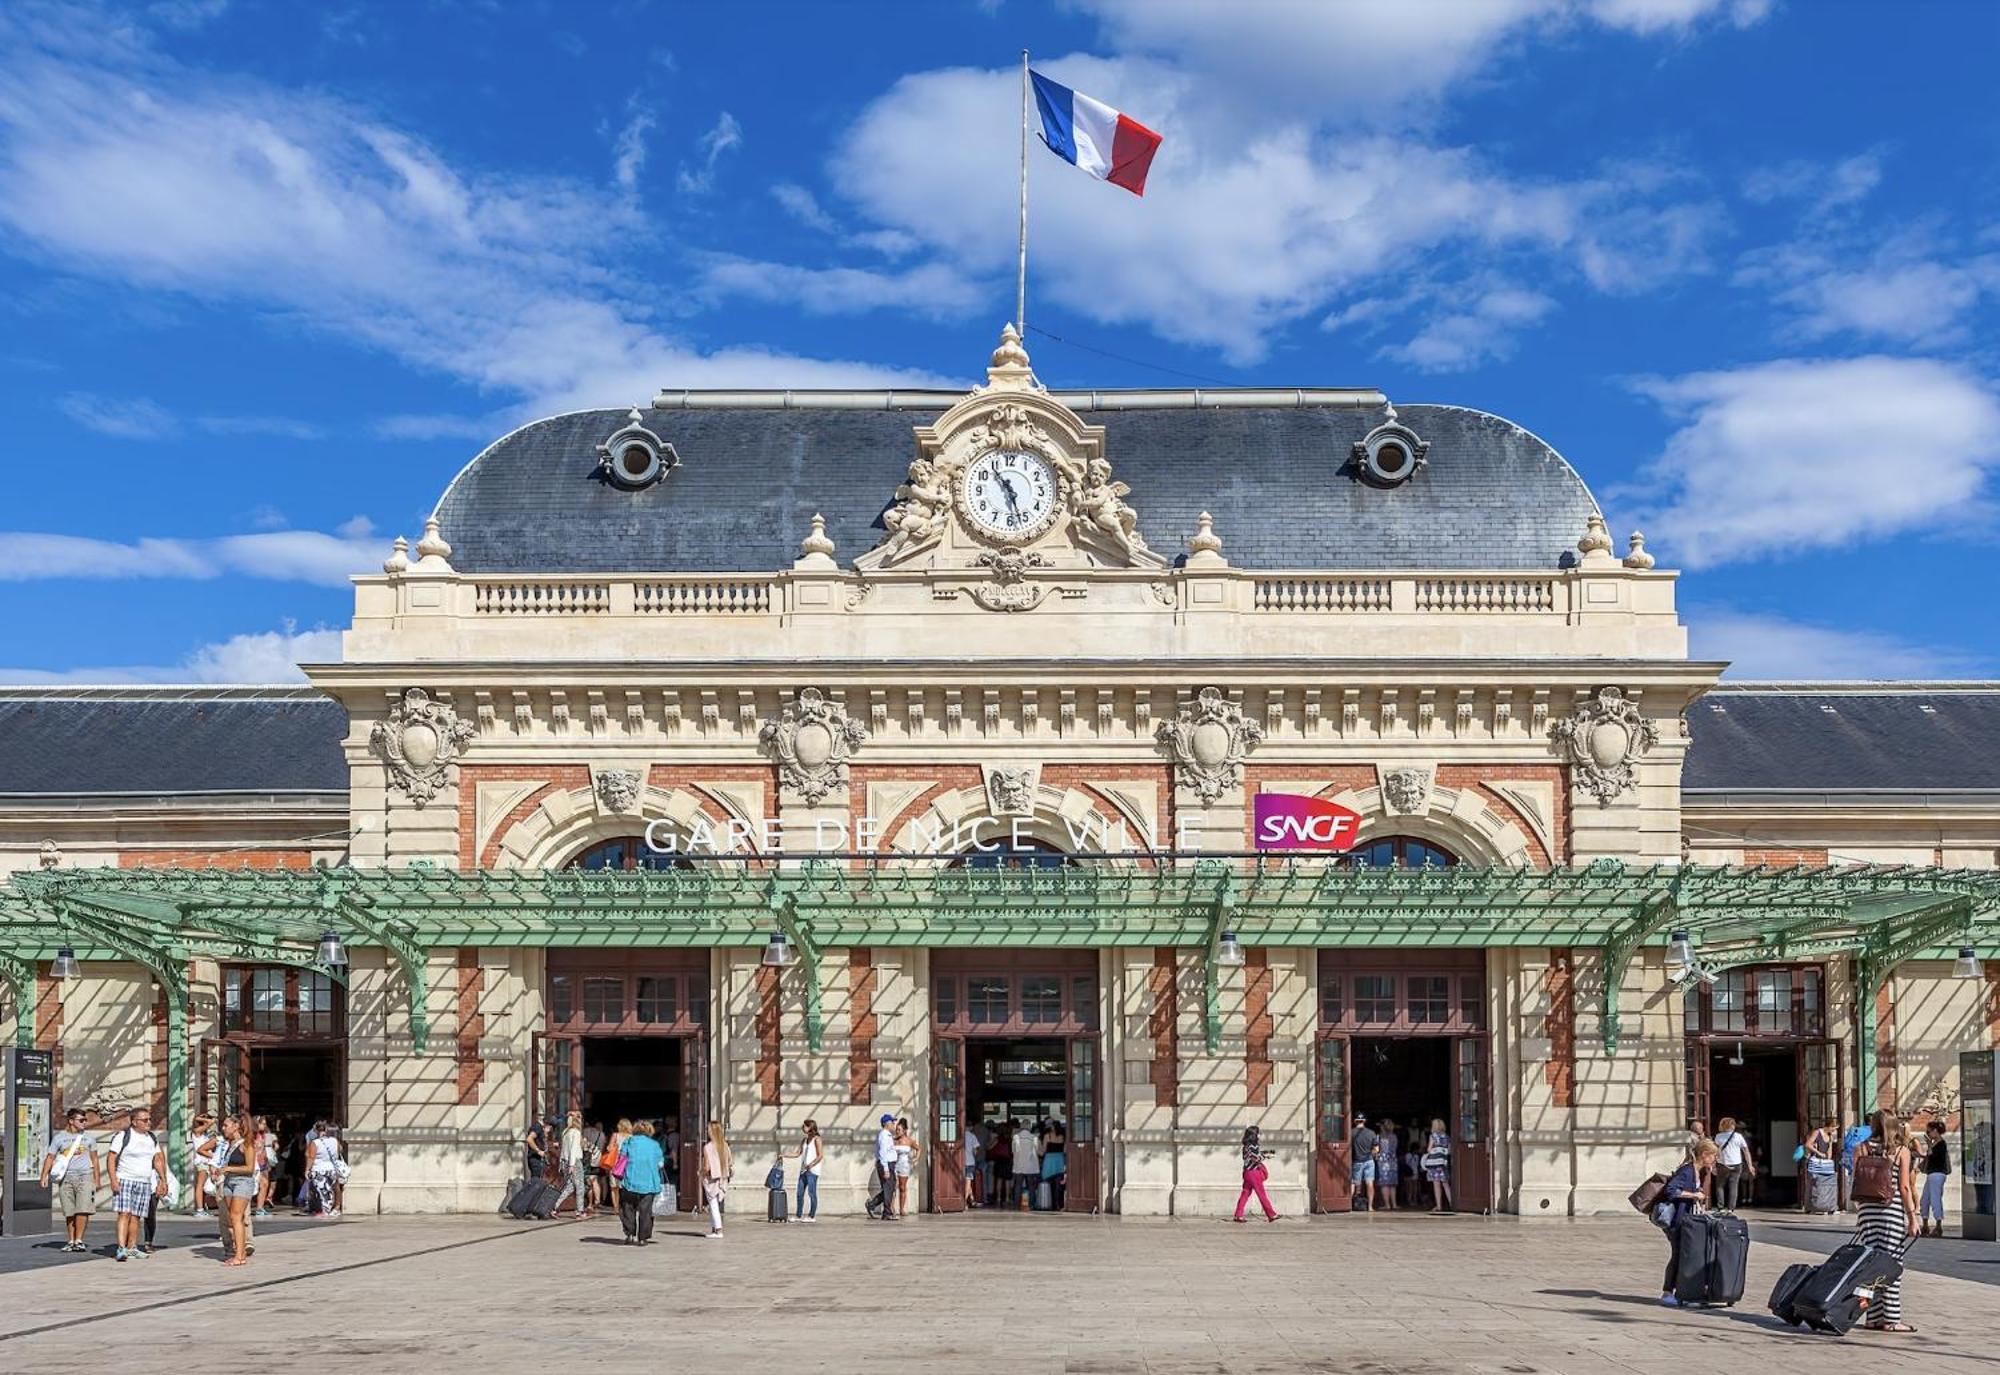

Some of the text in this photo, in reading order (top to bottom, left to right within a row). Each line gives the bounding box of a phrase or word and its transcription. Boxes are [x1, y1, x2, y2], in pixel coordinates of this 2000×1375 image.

[991, 460, 999, 470] 11
[1004, 455, 1016, 467] 12
[1023, 460, 1028, 471] 1
[978, 470, 989, 481] 10
[1033, 471, 1040, 482] 2
[975, 485, 983, 496] 9
[1038, 486, 1045, 497] 3
[979, 500, 986, 511] 8
[1033, 501, 1040, 511] 4
[991, 511, 998, 522] 7
[1006, 515, 1014, 527] 6
[1022, 511, 1029, 522] 5
[645, 815, 1203, 853] GARE DE NICE VILLE
[1258, 815, 1355, 842] SNCF
